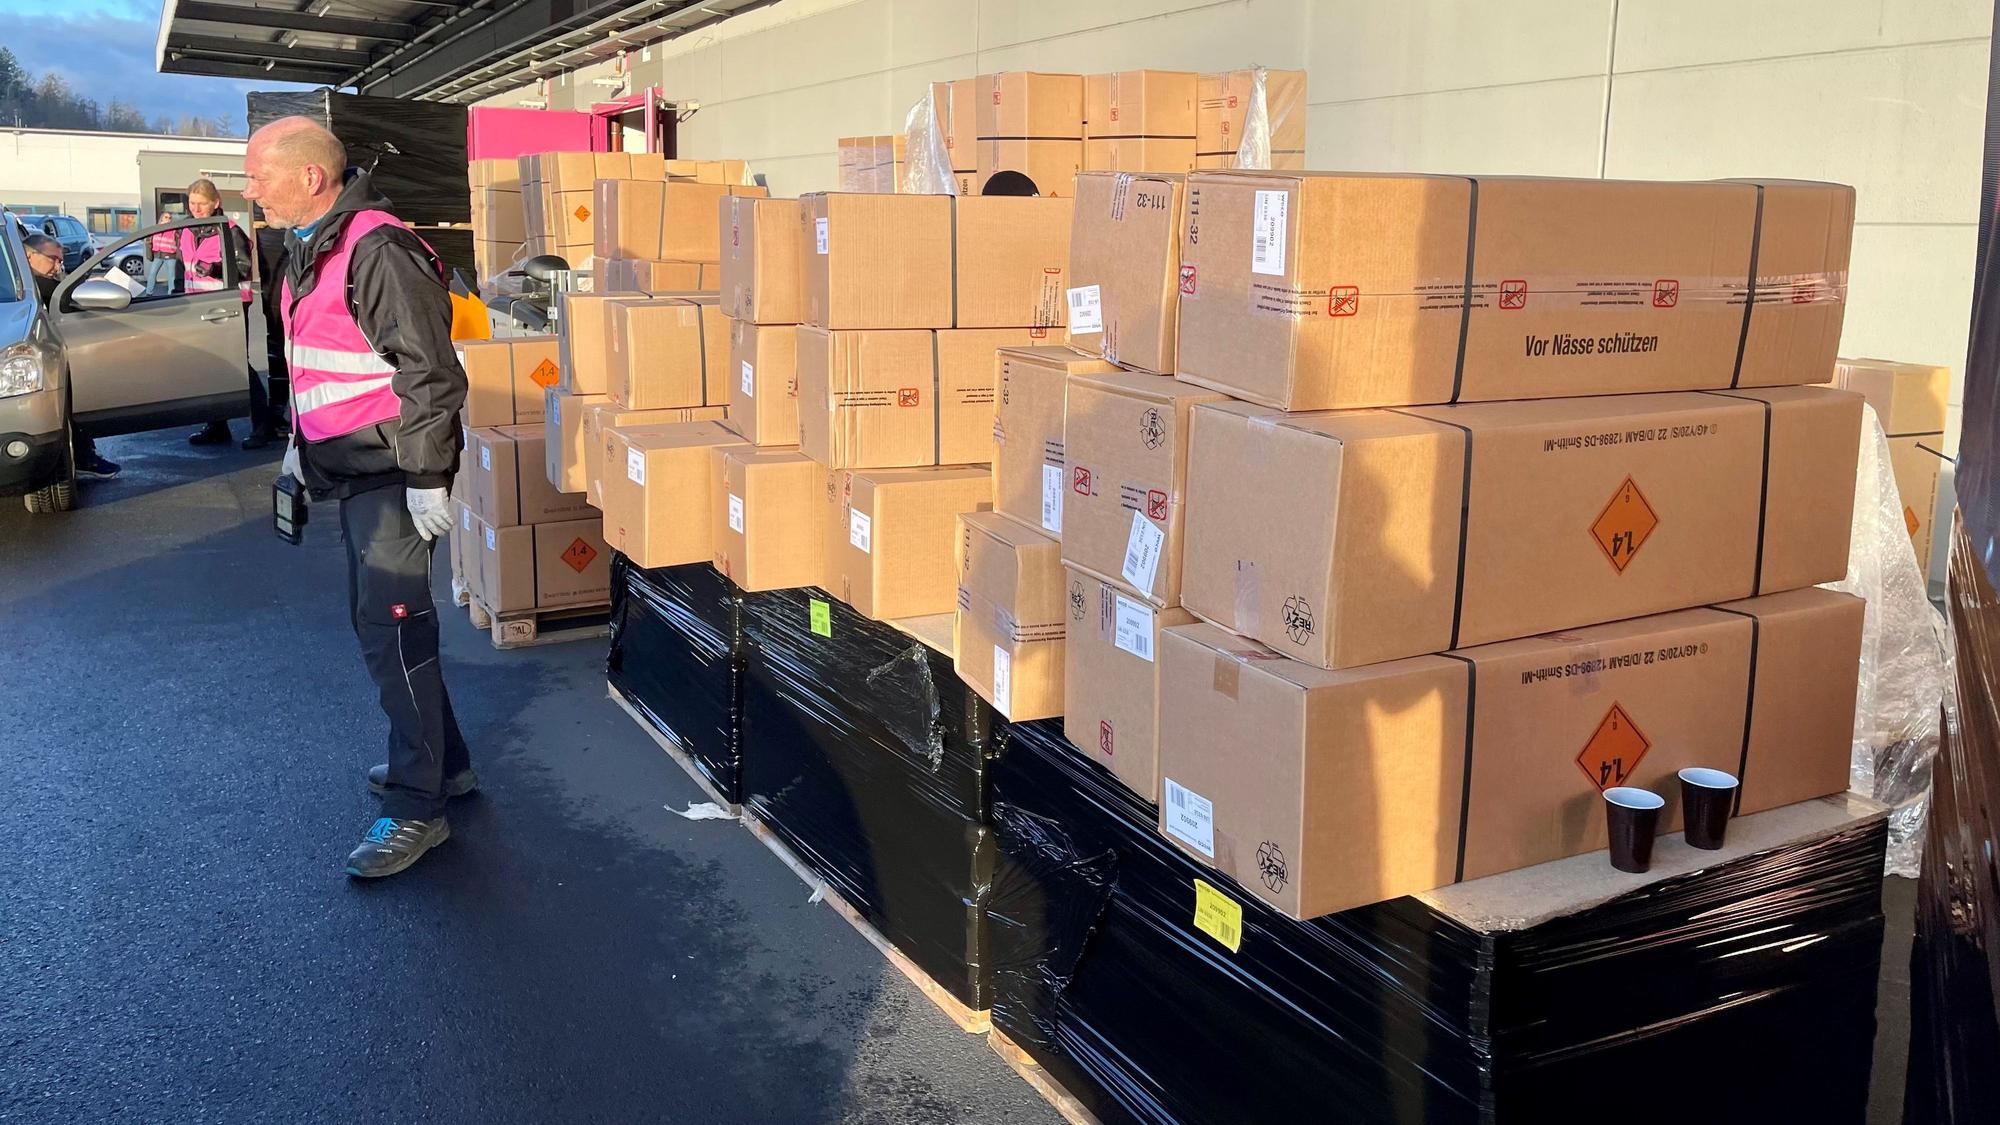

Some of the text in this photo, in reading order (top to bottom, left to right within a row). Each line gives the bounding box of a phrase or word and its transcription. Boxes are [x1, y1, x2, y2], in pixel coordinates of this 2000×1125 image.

[1136, 193, 1165, 210] 111-32
[1190, 189, 1200, 244] 111-32
[1525, 332, 1659, 357] Vor Nässe schützen
[540, 366, 555, 377] 1.4
[1584, 432, 1623, 448] 12898-DS
[1625, 429, 1656, 443] /D/BAM
[1657, 428, 1668, 441] 22
[1543, 436, 1582, 452] Smith-MI
[570, 545, 588, 557] 1.4
[1611, 530, 1635, 558] 1.4
[1609, 654, 1641, 670] /D/BAM
[1644, 651, 1654, 665] 22
[1565, 658, 1607, 676] 12898-DS
[1521, 666, 1563, 685] Smith-MI
[1599, 758, 1624, 786] 1.4
